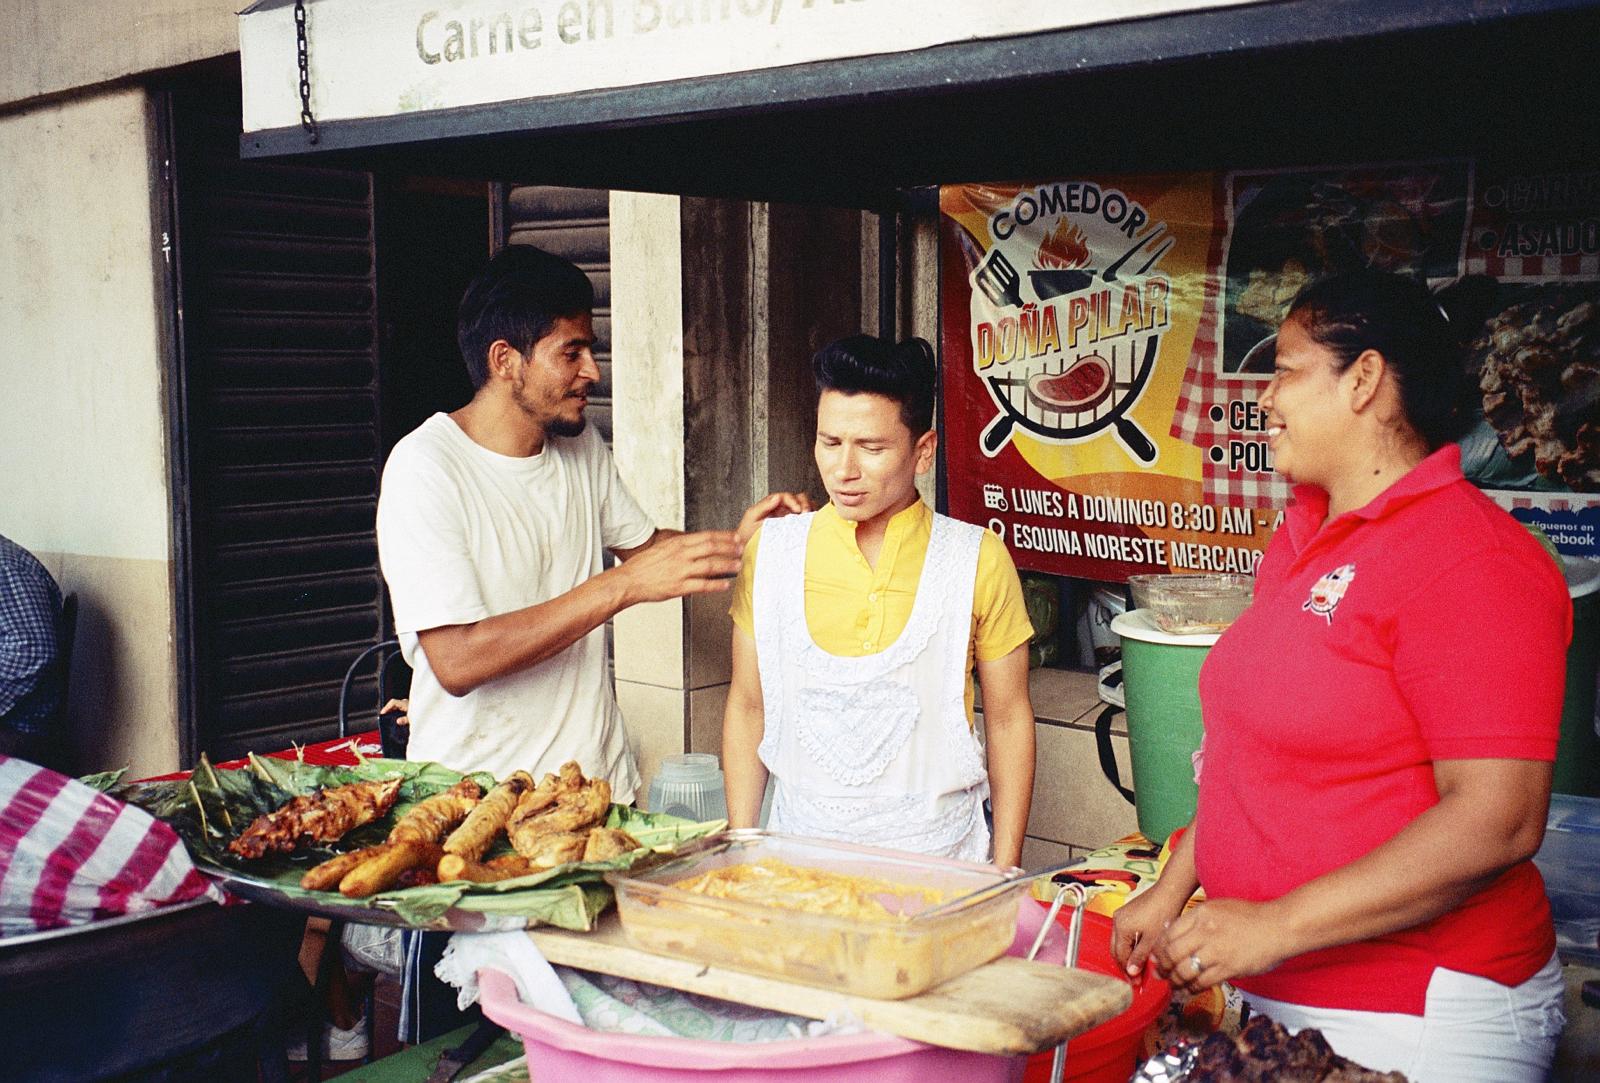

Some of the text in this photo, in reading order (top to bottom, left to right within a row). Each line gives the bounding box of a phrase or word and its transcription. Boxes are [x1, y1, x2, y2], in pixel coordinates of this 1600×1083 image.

[416, 8, 543, 65] Carne
[558, 0, 615, 44] en
[992, 184, 1145, 239] COMEDOR
[977, 276, 1169, 370] DOÑA PILAR
[1012, 488, 1064, 518] LUNES
[1068, 494, 1079, 520] A
[1083, 495, 1167, 528] DOMINGO
[1171, 502, 1216, 532] 8:30
[1221, 506, 1253, 535] AM
[1580, 524, 1595, 532] en
[1013, 523, 1083, 556] ESQUINA
[1084, 532, 1167, 566] NORESTE
[1547, 532, 1596, 546] ebook
